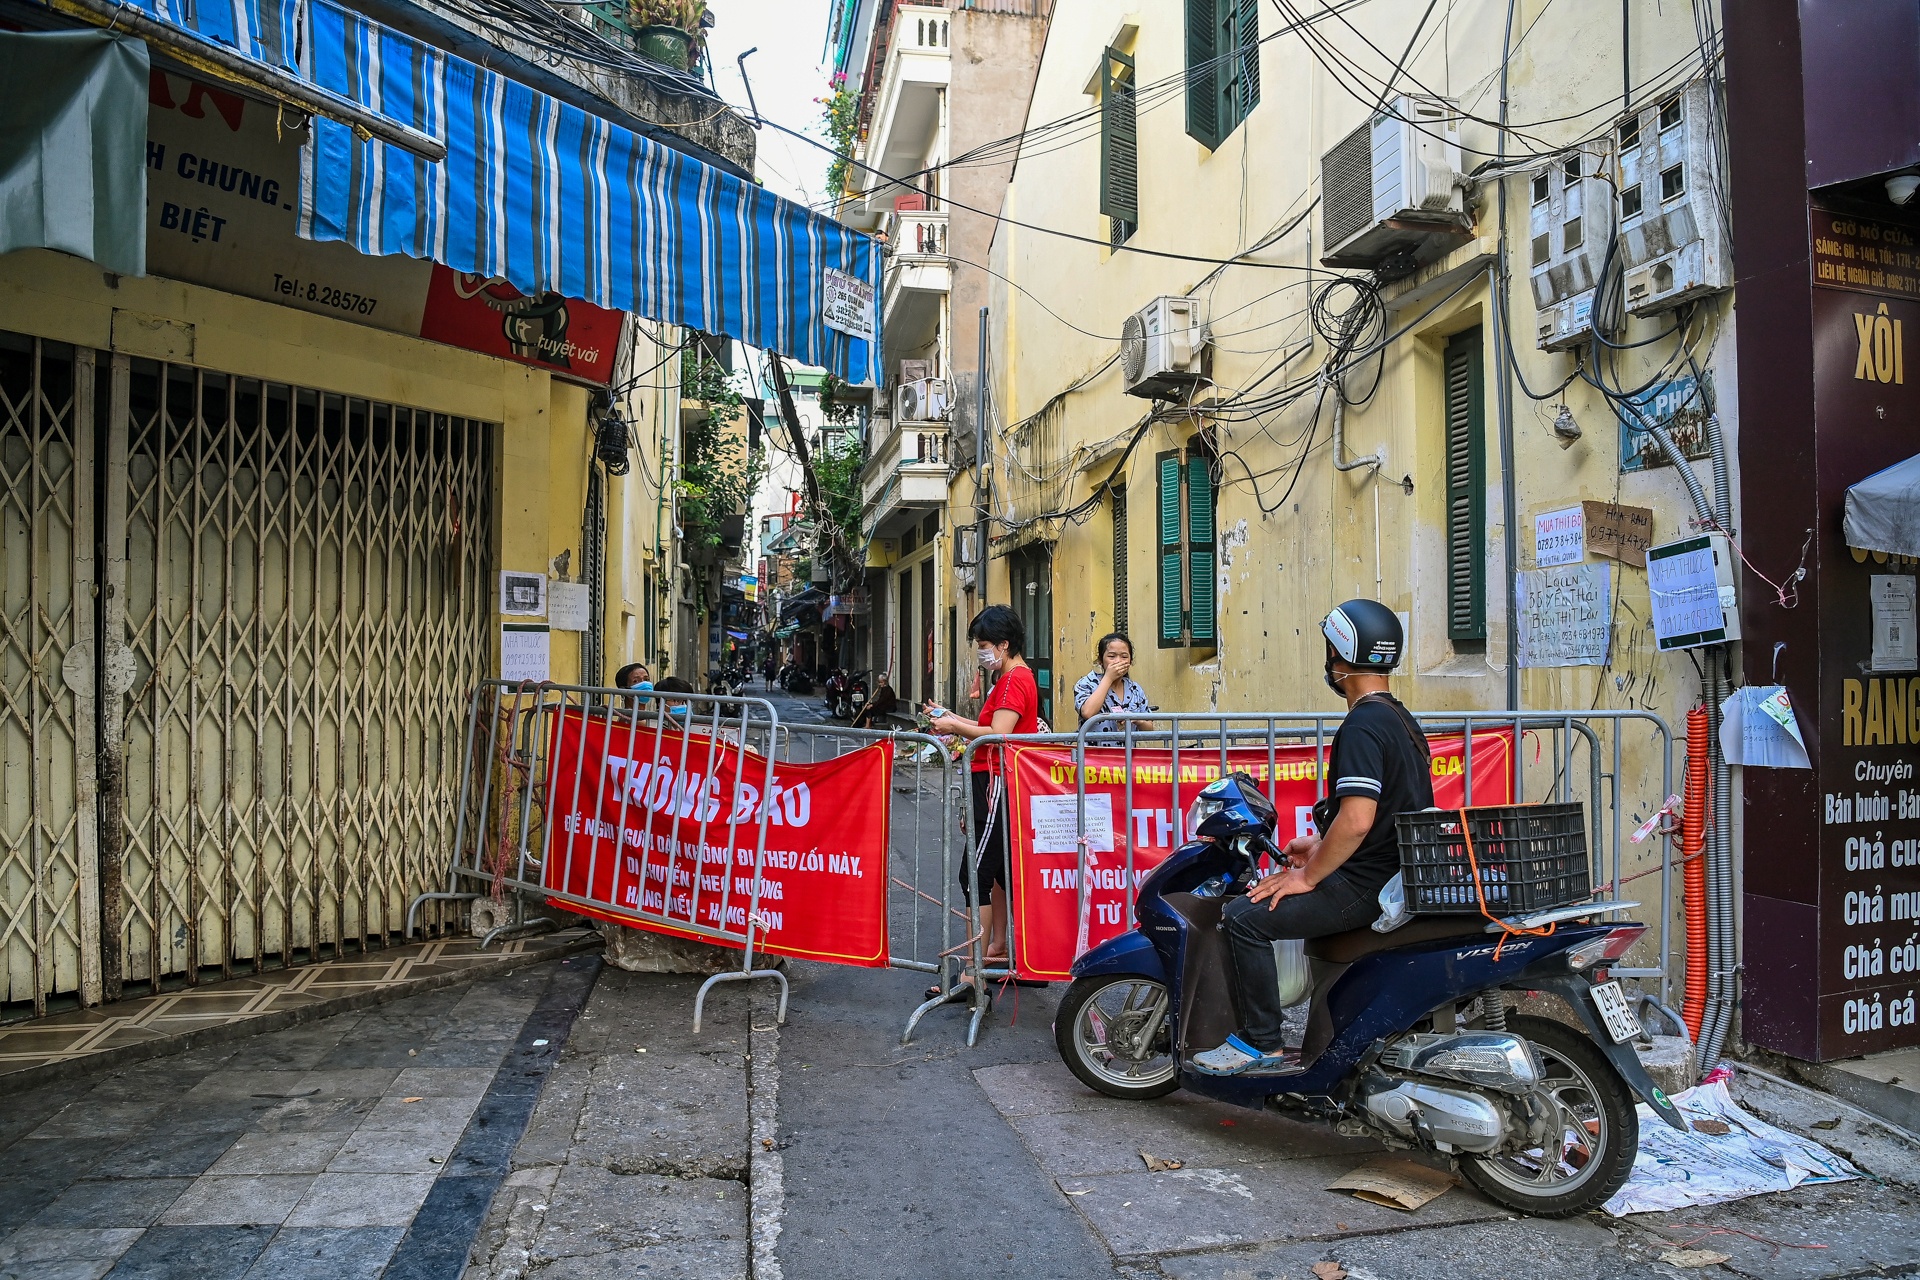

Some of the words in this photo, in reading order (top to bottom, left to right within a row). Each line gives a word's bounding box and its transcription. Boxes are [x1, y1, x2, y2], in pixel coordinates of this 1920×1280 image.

[176, 152, 280, 206] CHƯNG
[159, 202, 227, 244] BIỆT
[1831, 219, 1857, 236] GIỜ
[1815, 236, 1842, 257] SÁNG:
[1843, 243, 1855, 259] 6H
[1896, 252, 1911, 269] 17H
[1817, 260, 1835, 280] LIÊN
[1836, 263, 1847, 285] HỆ
[1847, 266, 1870, 286] NGOÀI
[306, 282, 377, 317] 8.285767
[537, 333, 577, 358] tuyệt
[577, 346, 600, 364] vời
[1853, 302, 1904, 385] XÔI
[1537, 520, 1554, 535] MUA
[1050, 760, 1077, 784] ỦY
[1084, 765, 1126, 784] BAN
[1136, 763, 1198, 784] NHÂN
[1855, 760, 1913, 785] Chuyên
[607, 755, 721, 824] THÔNG
[726, 777, 811, 827] BÁO
[1825, 793, 1852, 825] Bán
[1855, 790, 1889, 822] buôn
[627, 856, 640, 875] DI
[737, 849, 754, 867] ĐI
[798, 847, 824, 872] LỐI
[829, 851, 863, 878] NÀY,
[1844, 831, 1885, 872] Chả
[1040, 868, 1078, 893] TẠM
[626, 885, 662, 909] HNG
[1096, 899, 1122, 925] TỪ
[1843, 885, 1884, 926] Chả
[1843, 938, 1883, 981] Chả
[1843, 992, 1883, 1035] Chả
[1889, 990, 1915, 1026] cá
